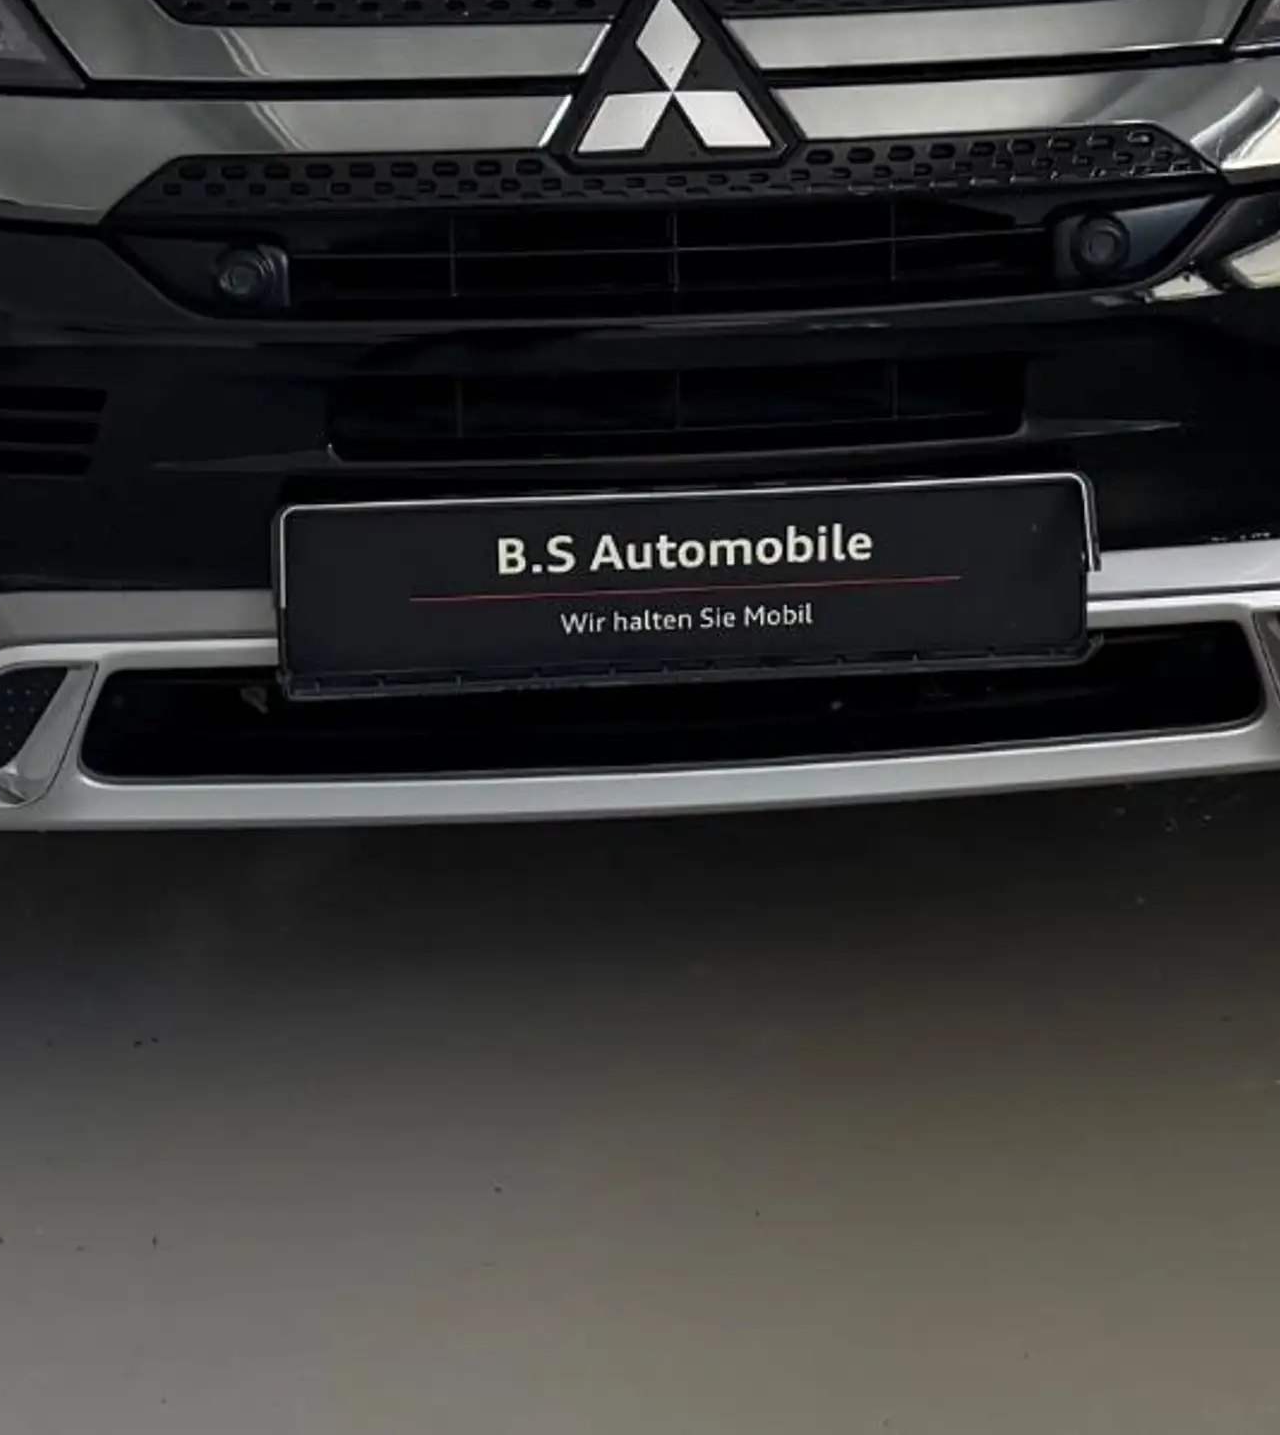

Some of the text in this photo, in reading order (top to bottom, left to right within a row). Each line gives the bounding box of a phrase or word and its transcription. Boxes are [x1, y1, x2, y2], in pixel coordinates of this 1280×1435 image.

[497, 522, 873, 575] B.S Automobile
[560, 602, 813, 635] Wir halten Sie Mobil
